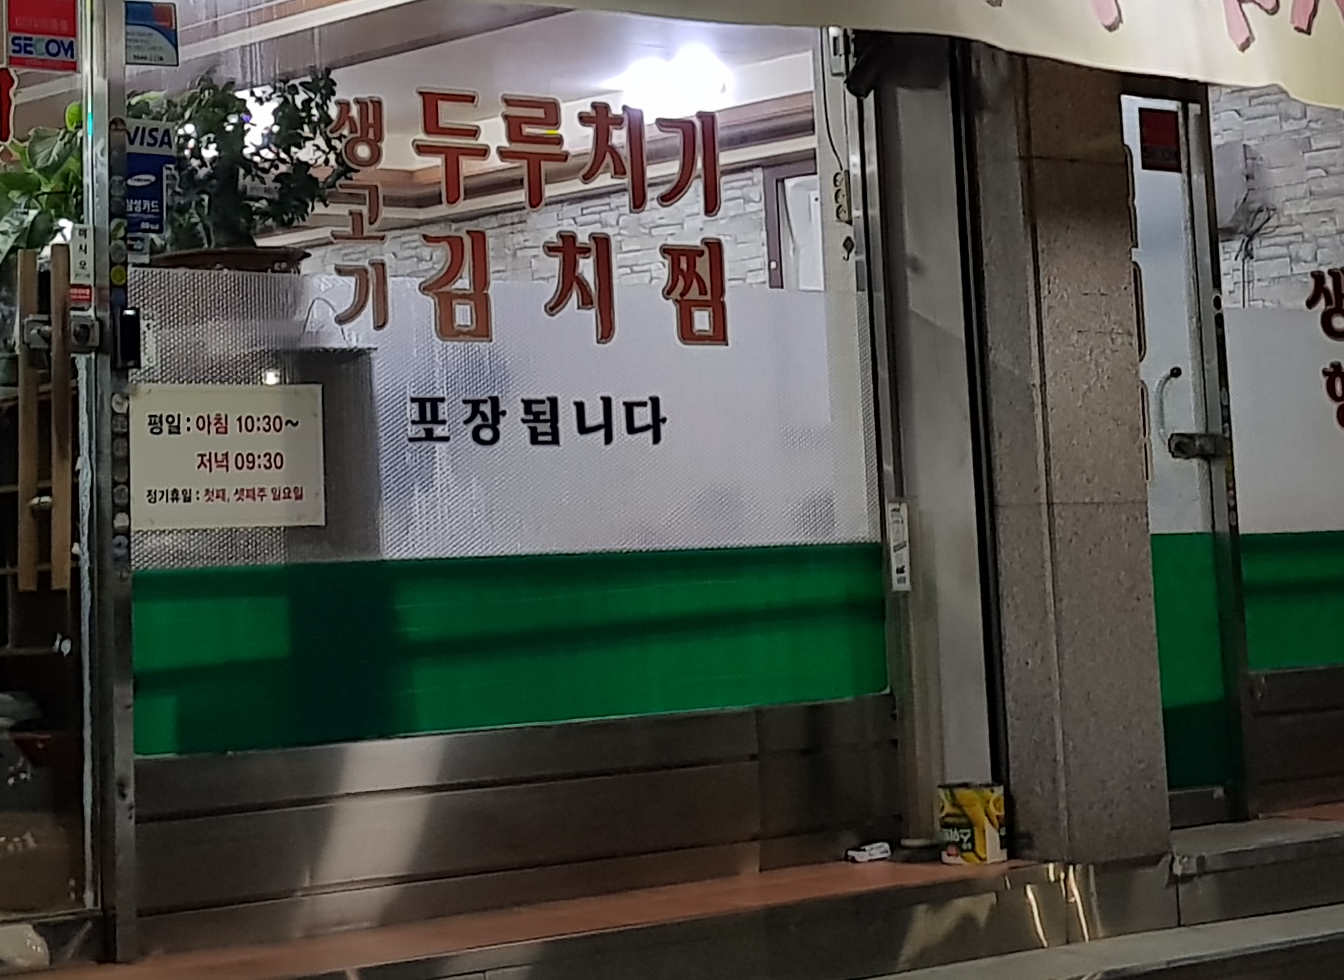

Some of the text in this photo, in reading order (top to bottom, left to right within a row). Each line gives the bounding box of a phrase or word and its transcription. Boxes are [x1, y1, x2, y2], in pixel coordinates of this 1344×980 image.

[10, 34, 76, 60] SECOM
[126, 124, 173, 149] VISA
[412, 87, 723, 218] 두루치기
[328, 95, 392, 332] 생고기
[416, 228, 731, 348] 김치찜
[196, 413, 229, 436] 아침
[406, 394, 668, 447] 포장됩니다
[196, 451, 285, 473] 저녁 09:30
[146, 488, 193, 504] 정기휴일
[271, 485, 305, 502] 일요일
